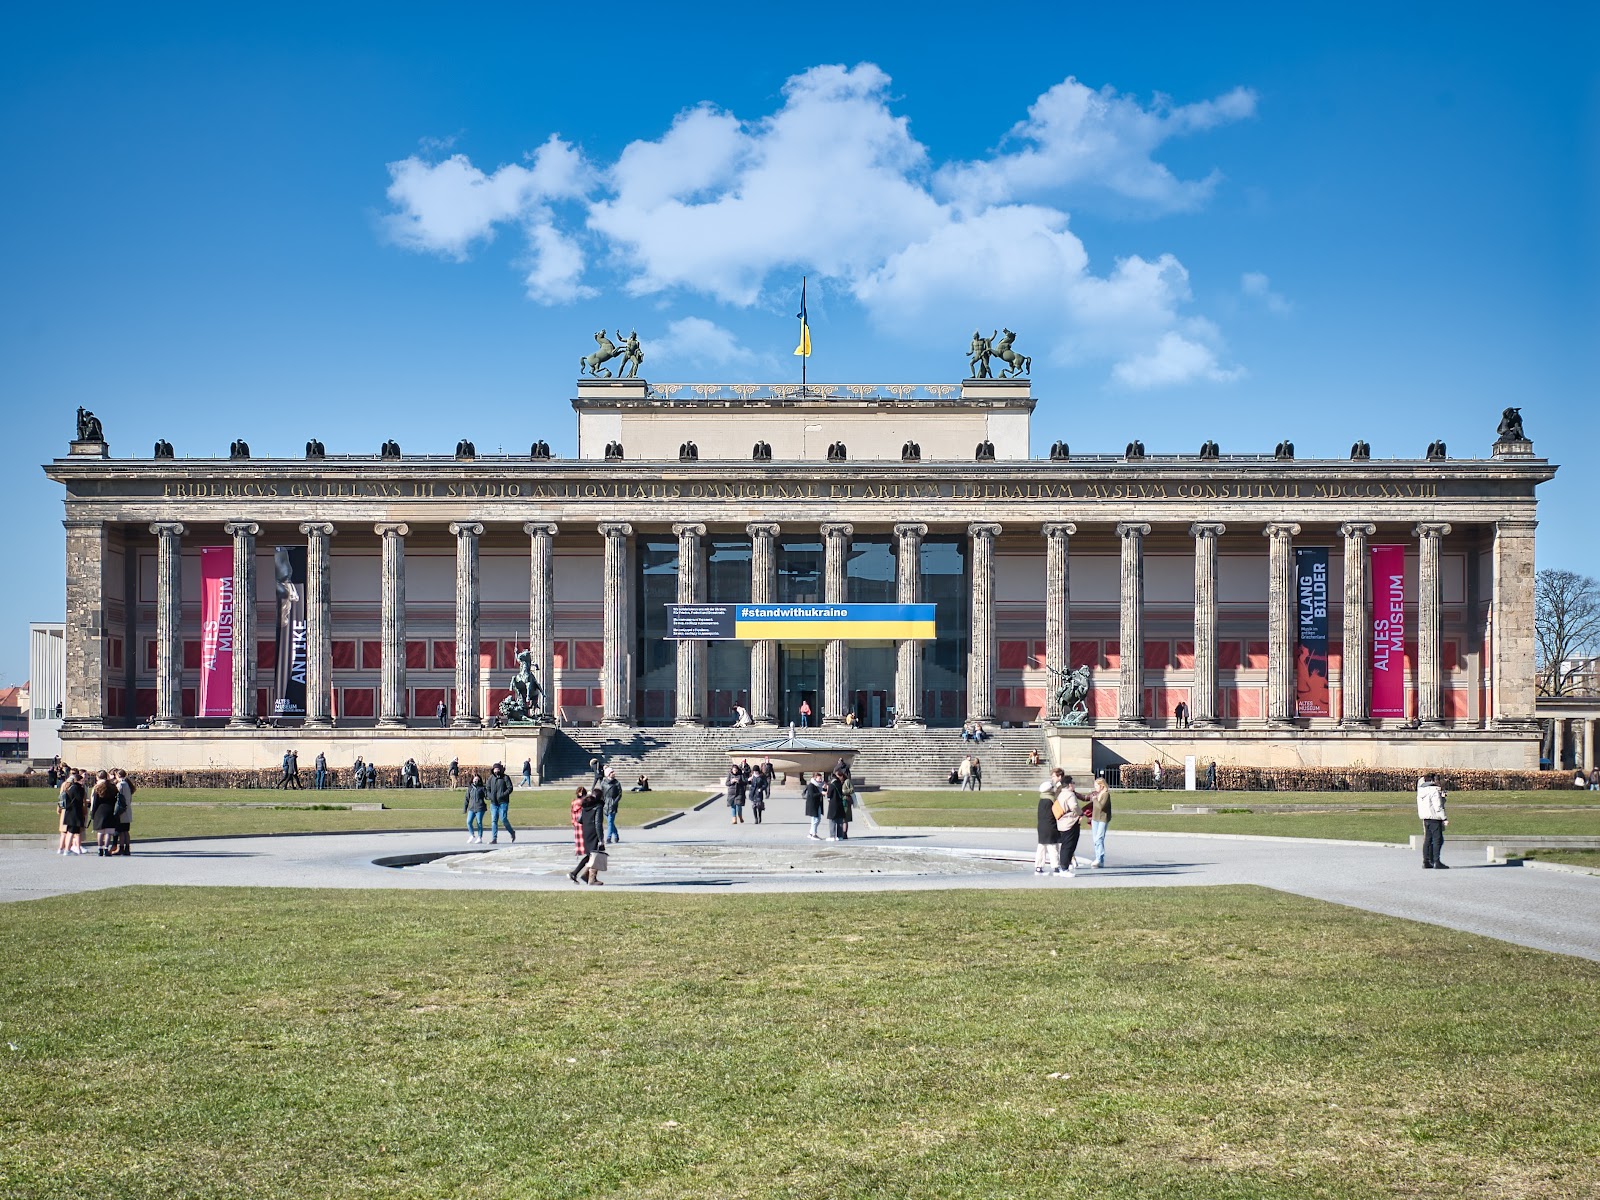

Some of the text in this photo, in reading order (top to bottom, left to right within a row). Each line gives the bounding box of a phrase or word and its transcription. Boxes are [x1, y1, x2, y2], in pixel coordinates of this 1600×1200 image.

[163, 483, 1438, 498] FRIDERICVS GVILELMVS III STVDIO ANTIQVITATIS OMNIGENAE ET ARTIVM LIBERALIVM MVSEVM CONSTITVIT MDCCCXXVIII
[219, 577, 232, 651] MUSEUM
[741, 608, 848, 618] #standwithukraine
[1301, 576, 1312, 624] KLANG
[1314, 563, 1326, 617] BILDER
[1390, 576, 1404, 651] MUSEUM
[204, 621, 218, 671] ALTES
[292, 620, 306, 684] ANTIKE
[1374, 620, 1388, 671] ALTES
